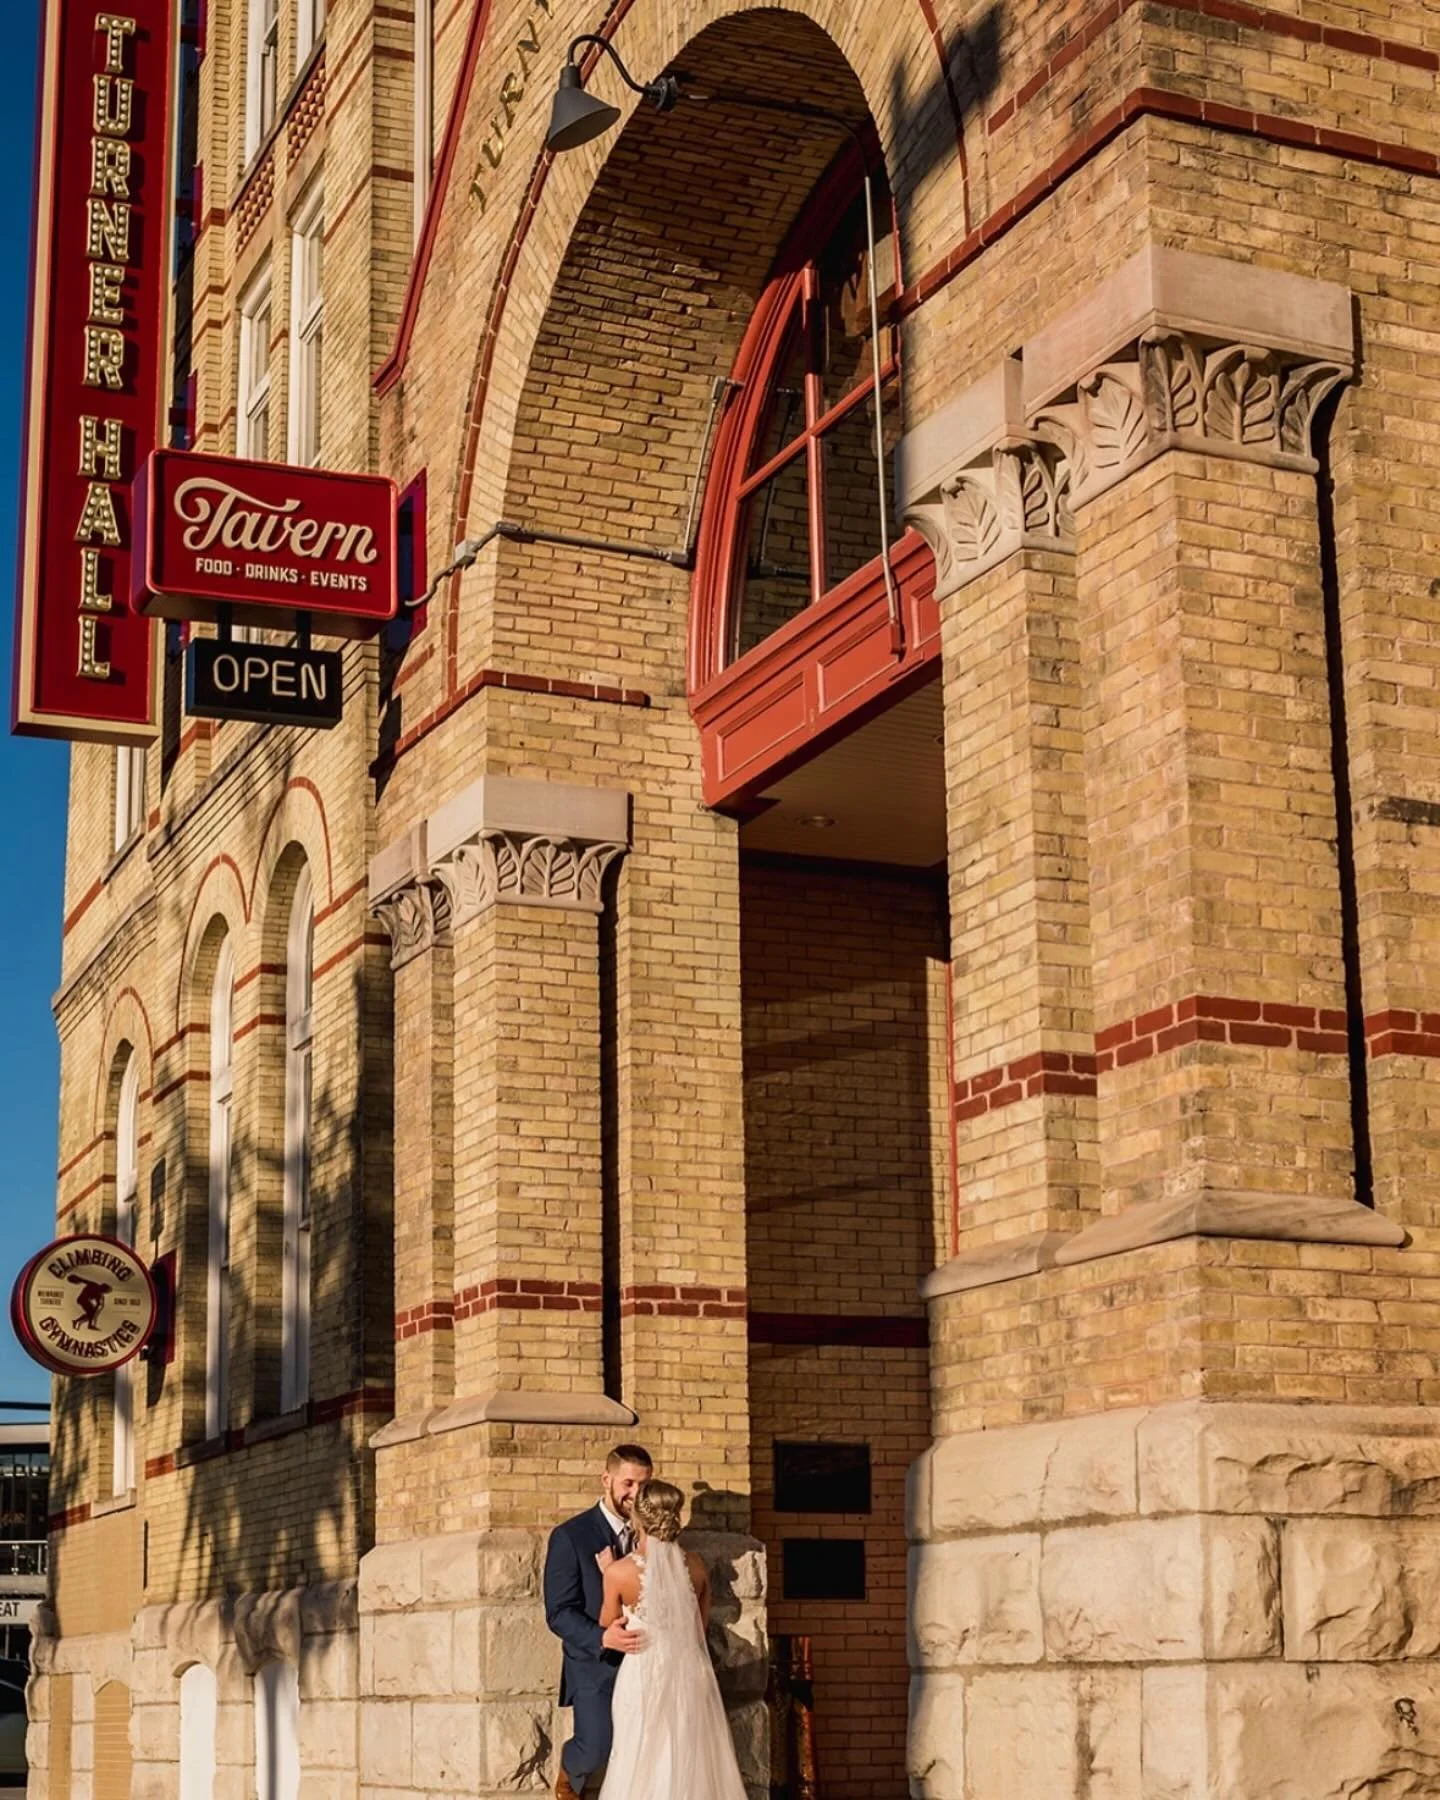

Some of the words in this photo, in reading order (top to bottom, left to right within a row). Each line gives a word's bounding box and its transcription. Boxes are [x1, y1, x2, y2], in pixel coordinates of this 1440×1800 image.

[82, 12, 136, 390] TURNER
[174, 477, 377, 563] Tavern
[74, 415, 123, 678] HALL
[195, 557, 233, 576] FOOD
[245, 563, 298, 583] DRINKS
[310, 571, 367, 592] EVENTS
[213, 653, 327, 701] OPEN
[48, 1248, 135, 1282] CLIMBING
[38, 1315, 141, 1359] GYMNASTICS
